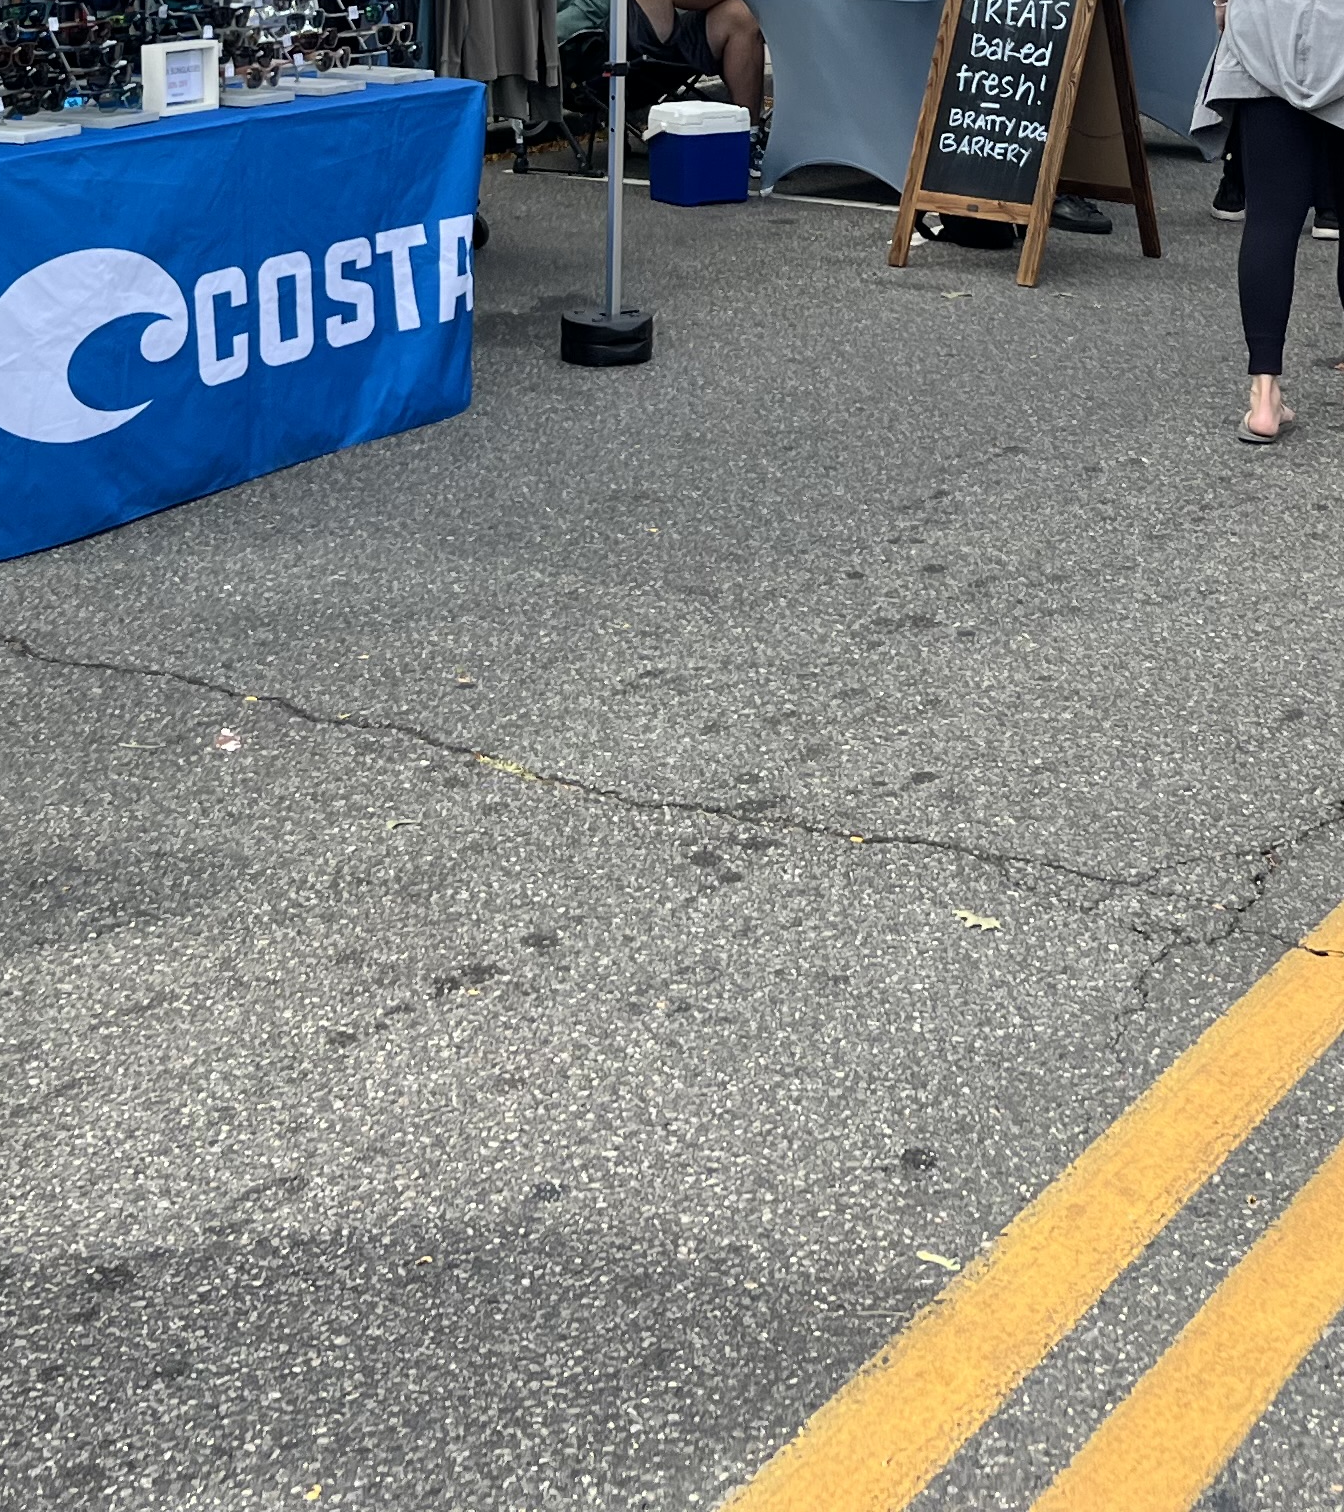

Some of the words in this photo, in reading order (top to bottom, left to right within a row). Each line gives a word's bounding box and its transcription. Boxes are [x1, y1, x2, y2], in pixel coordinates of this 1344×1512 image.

[970, 33, 1053, 68] Baked
[955, 64, 1047, 106] fresh!
[948, 107, 1017, 137] BRATTY
[1017, 120, 1049, 143] DOG
[938, 132, 1033, 168] BARKERY
[194, 213, 474, 387] COSTA
